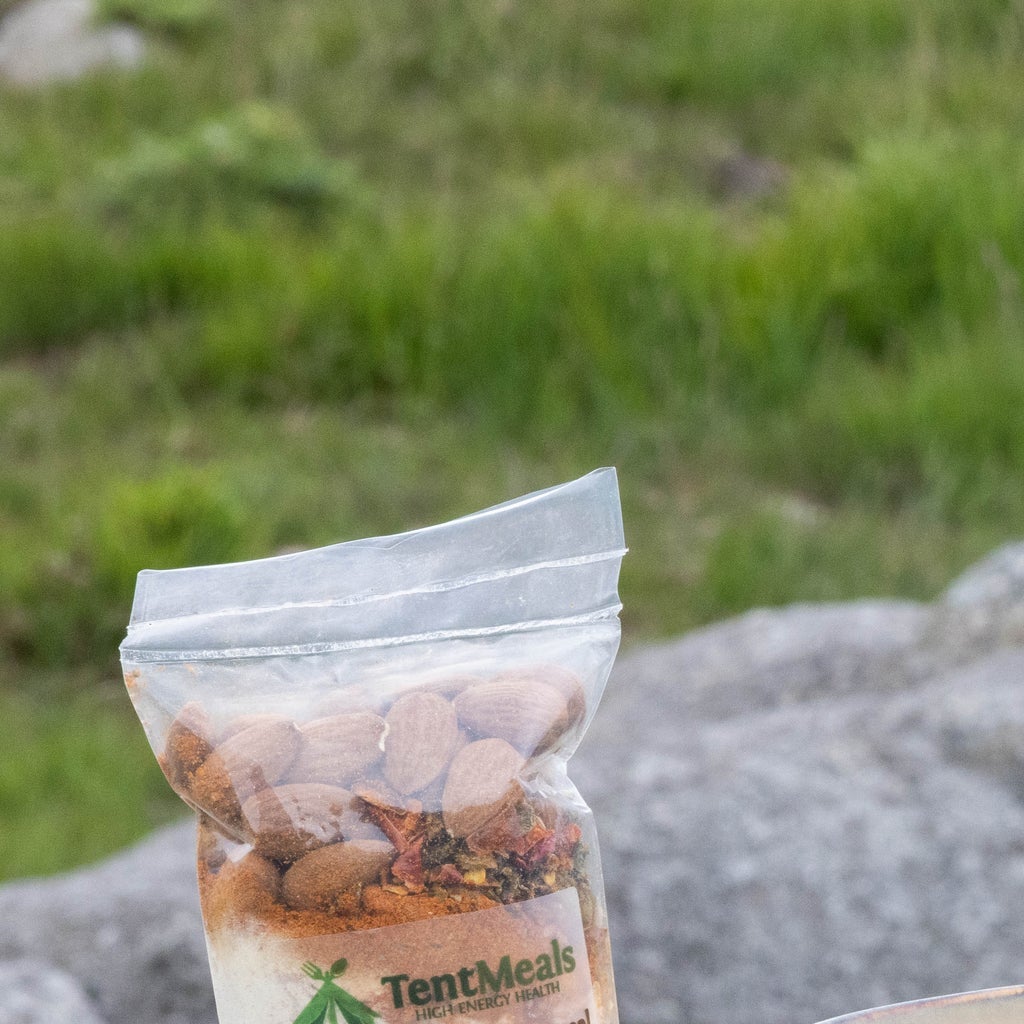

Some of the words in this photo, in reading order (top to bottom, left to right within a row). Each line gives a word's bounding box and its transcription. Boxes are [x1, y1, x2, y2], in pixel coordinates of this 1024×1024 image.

[381, 939, 577, 1009] TentMeals
[416, 1004, 453, 1021] HIGH
[458, 993, 511, 1014] ENERGY
[515, 981, 560, 1002] HEALTH
